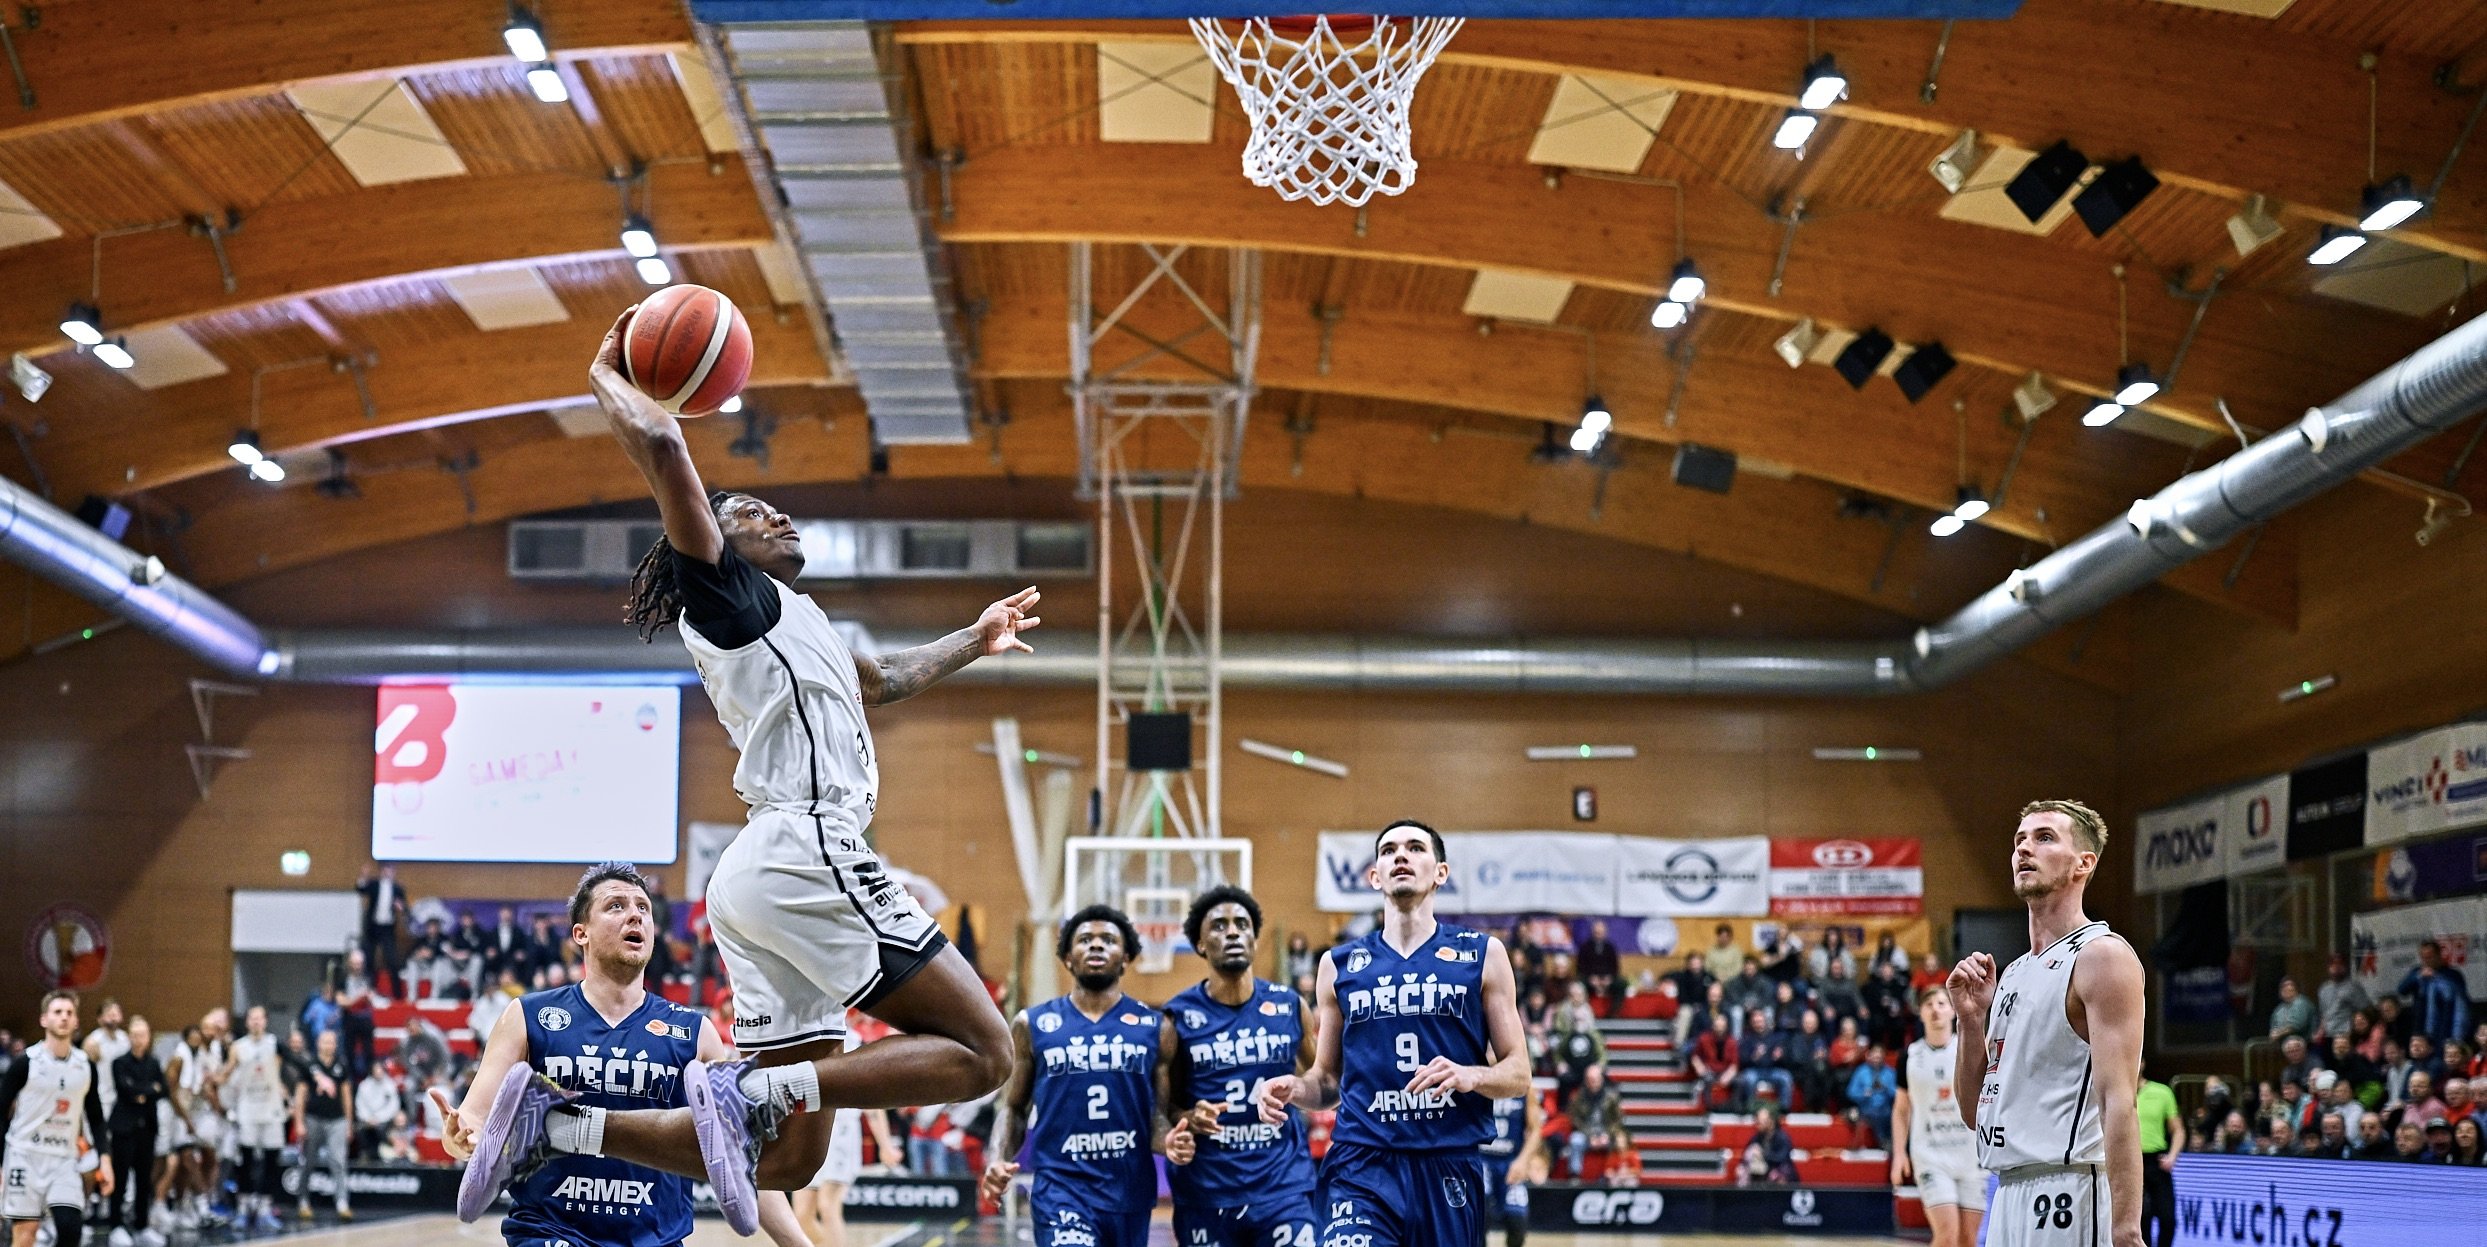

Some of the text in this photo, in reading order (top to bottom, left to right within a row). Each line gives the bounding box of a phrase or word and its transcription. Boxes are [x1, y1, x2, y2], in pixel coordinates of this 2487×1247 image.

[1348, 973, 1467, 1024] DĚČÍN
[1998, 992, 2018, 1016] 98
[1043, 1034, 1147, 1077] DĚČÍN
[1189, 1027, 1291, 1071] DĚČÍN
[1395, 1032, 1420, 1072] 9
[544, 1044, 680, 1101] DĚČÍN
[1087, 1085, 1109, 1120] 2
[1367, 1088, 1456, 1112] ARMEX
[1380, 1111, 1444, 1123] ENERGY
[1061, 1130, 1137, 1153] ARMEX
[551, 1175, 654, 1206] ARMEX
[1572, 1191, 1664, 1224] era
[566, 1202, 641, 1216] ENERGY
[2034, 1192, 2073, 1230] 98
